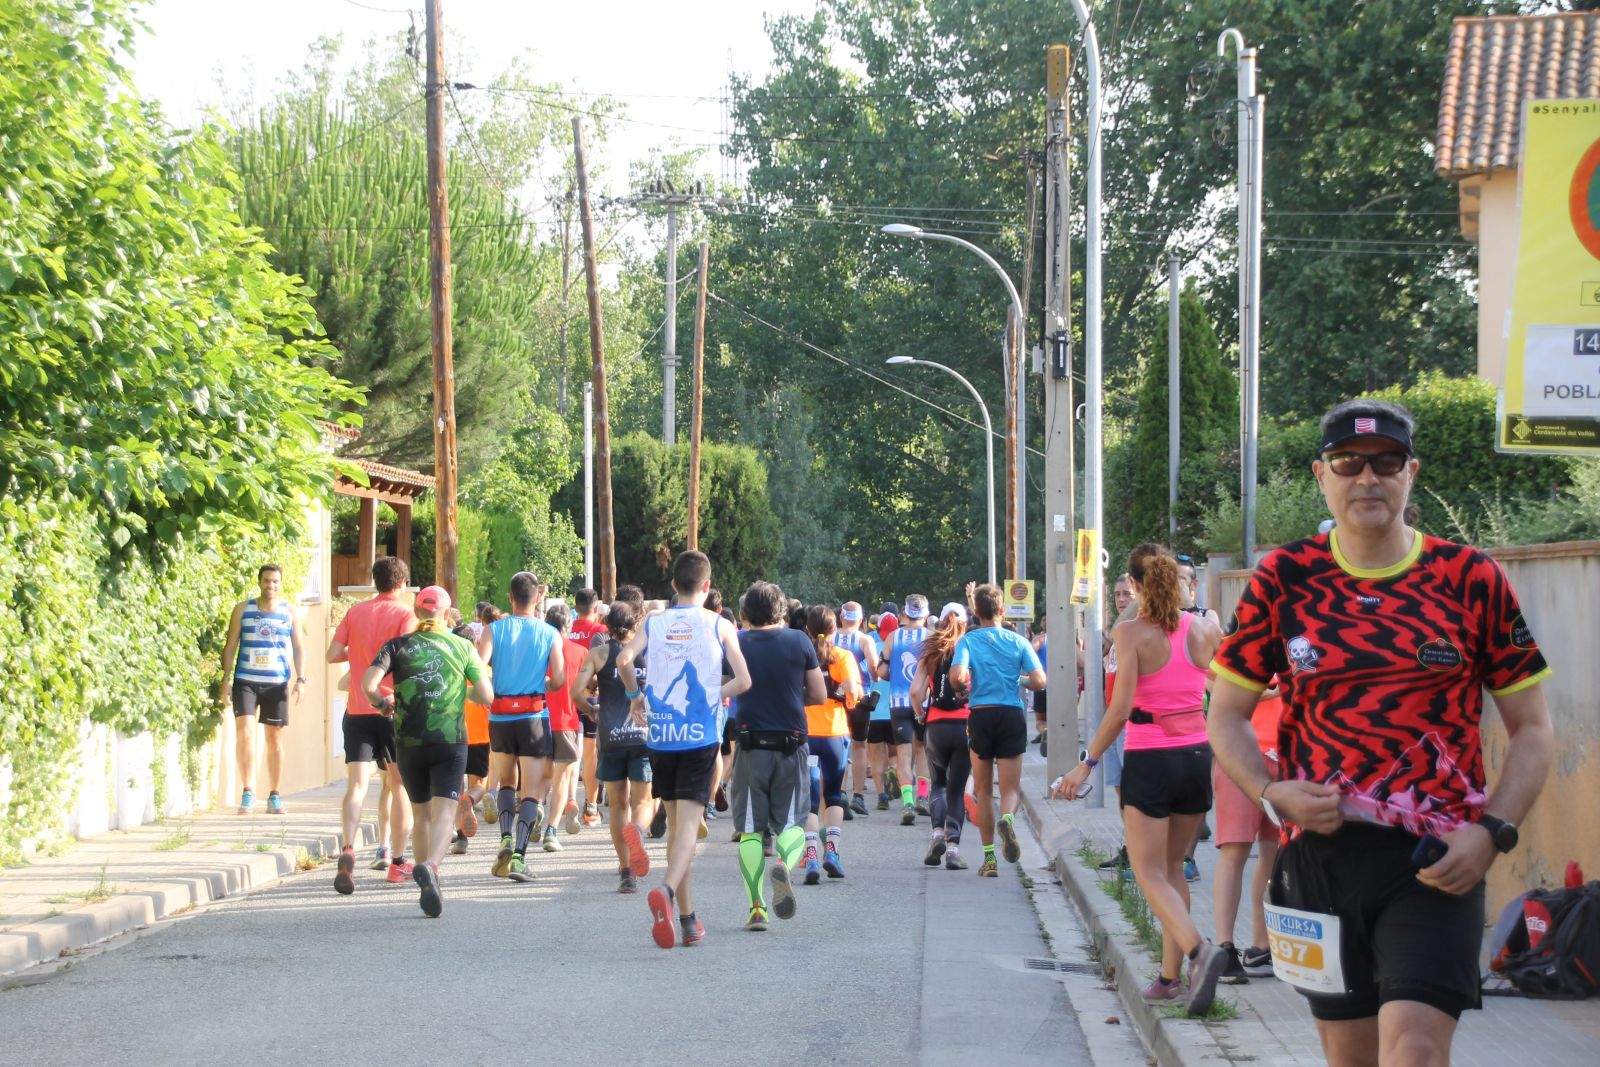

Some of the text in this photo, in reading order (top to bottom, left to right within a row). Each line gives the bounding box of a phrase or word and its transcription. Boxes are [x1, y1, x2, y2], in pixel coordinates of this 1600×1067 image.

[1542, 103, 1600, 116] Senyal
[652, 712, 673, 720] CLUB
[649, 722, 704, 743] CIMS
[1280, 916, 1317, 934] CURSA
